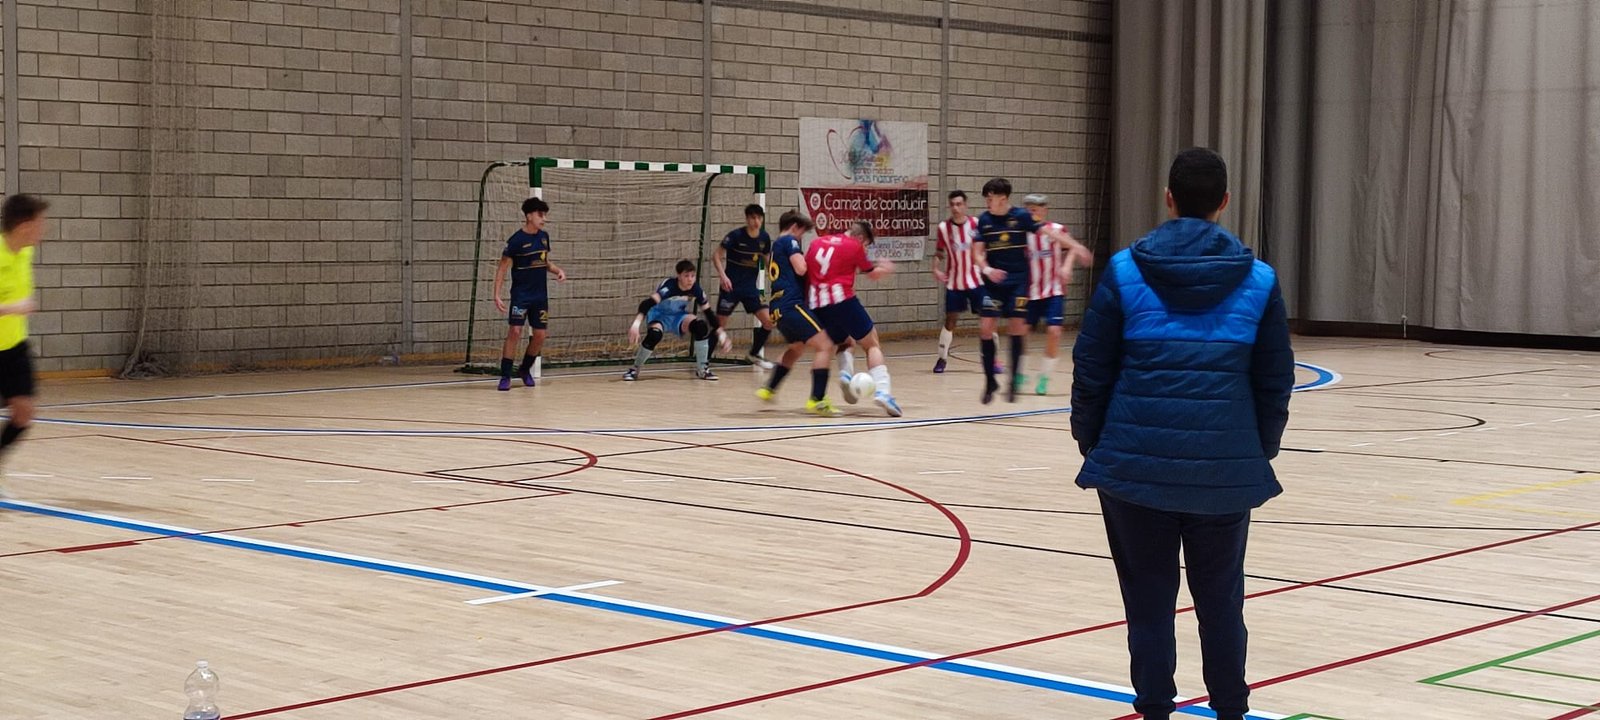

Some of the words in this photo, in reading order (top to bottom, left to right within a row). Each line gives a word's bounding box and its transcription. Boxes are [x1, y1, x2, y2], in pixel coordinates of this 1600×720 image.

[824, 193, 862, 210] Carnet
[864, 194, 878, 210] de
[880, 194, 927, 211] conducir
[876, 213, 890, 230] de
[891, 219, 926, 230] armas
[815, 246, 835, 276] 4
